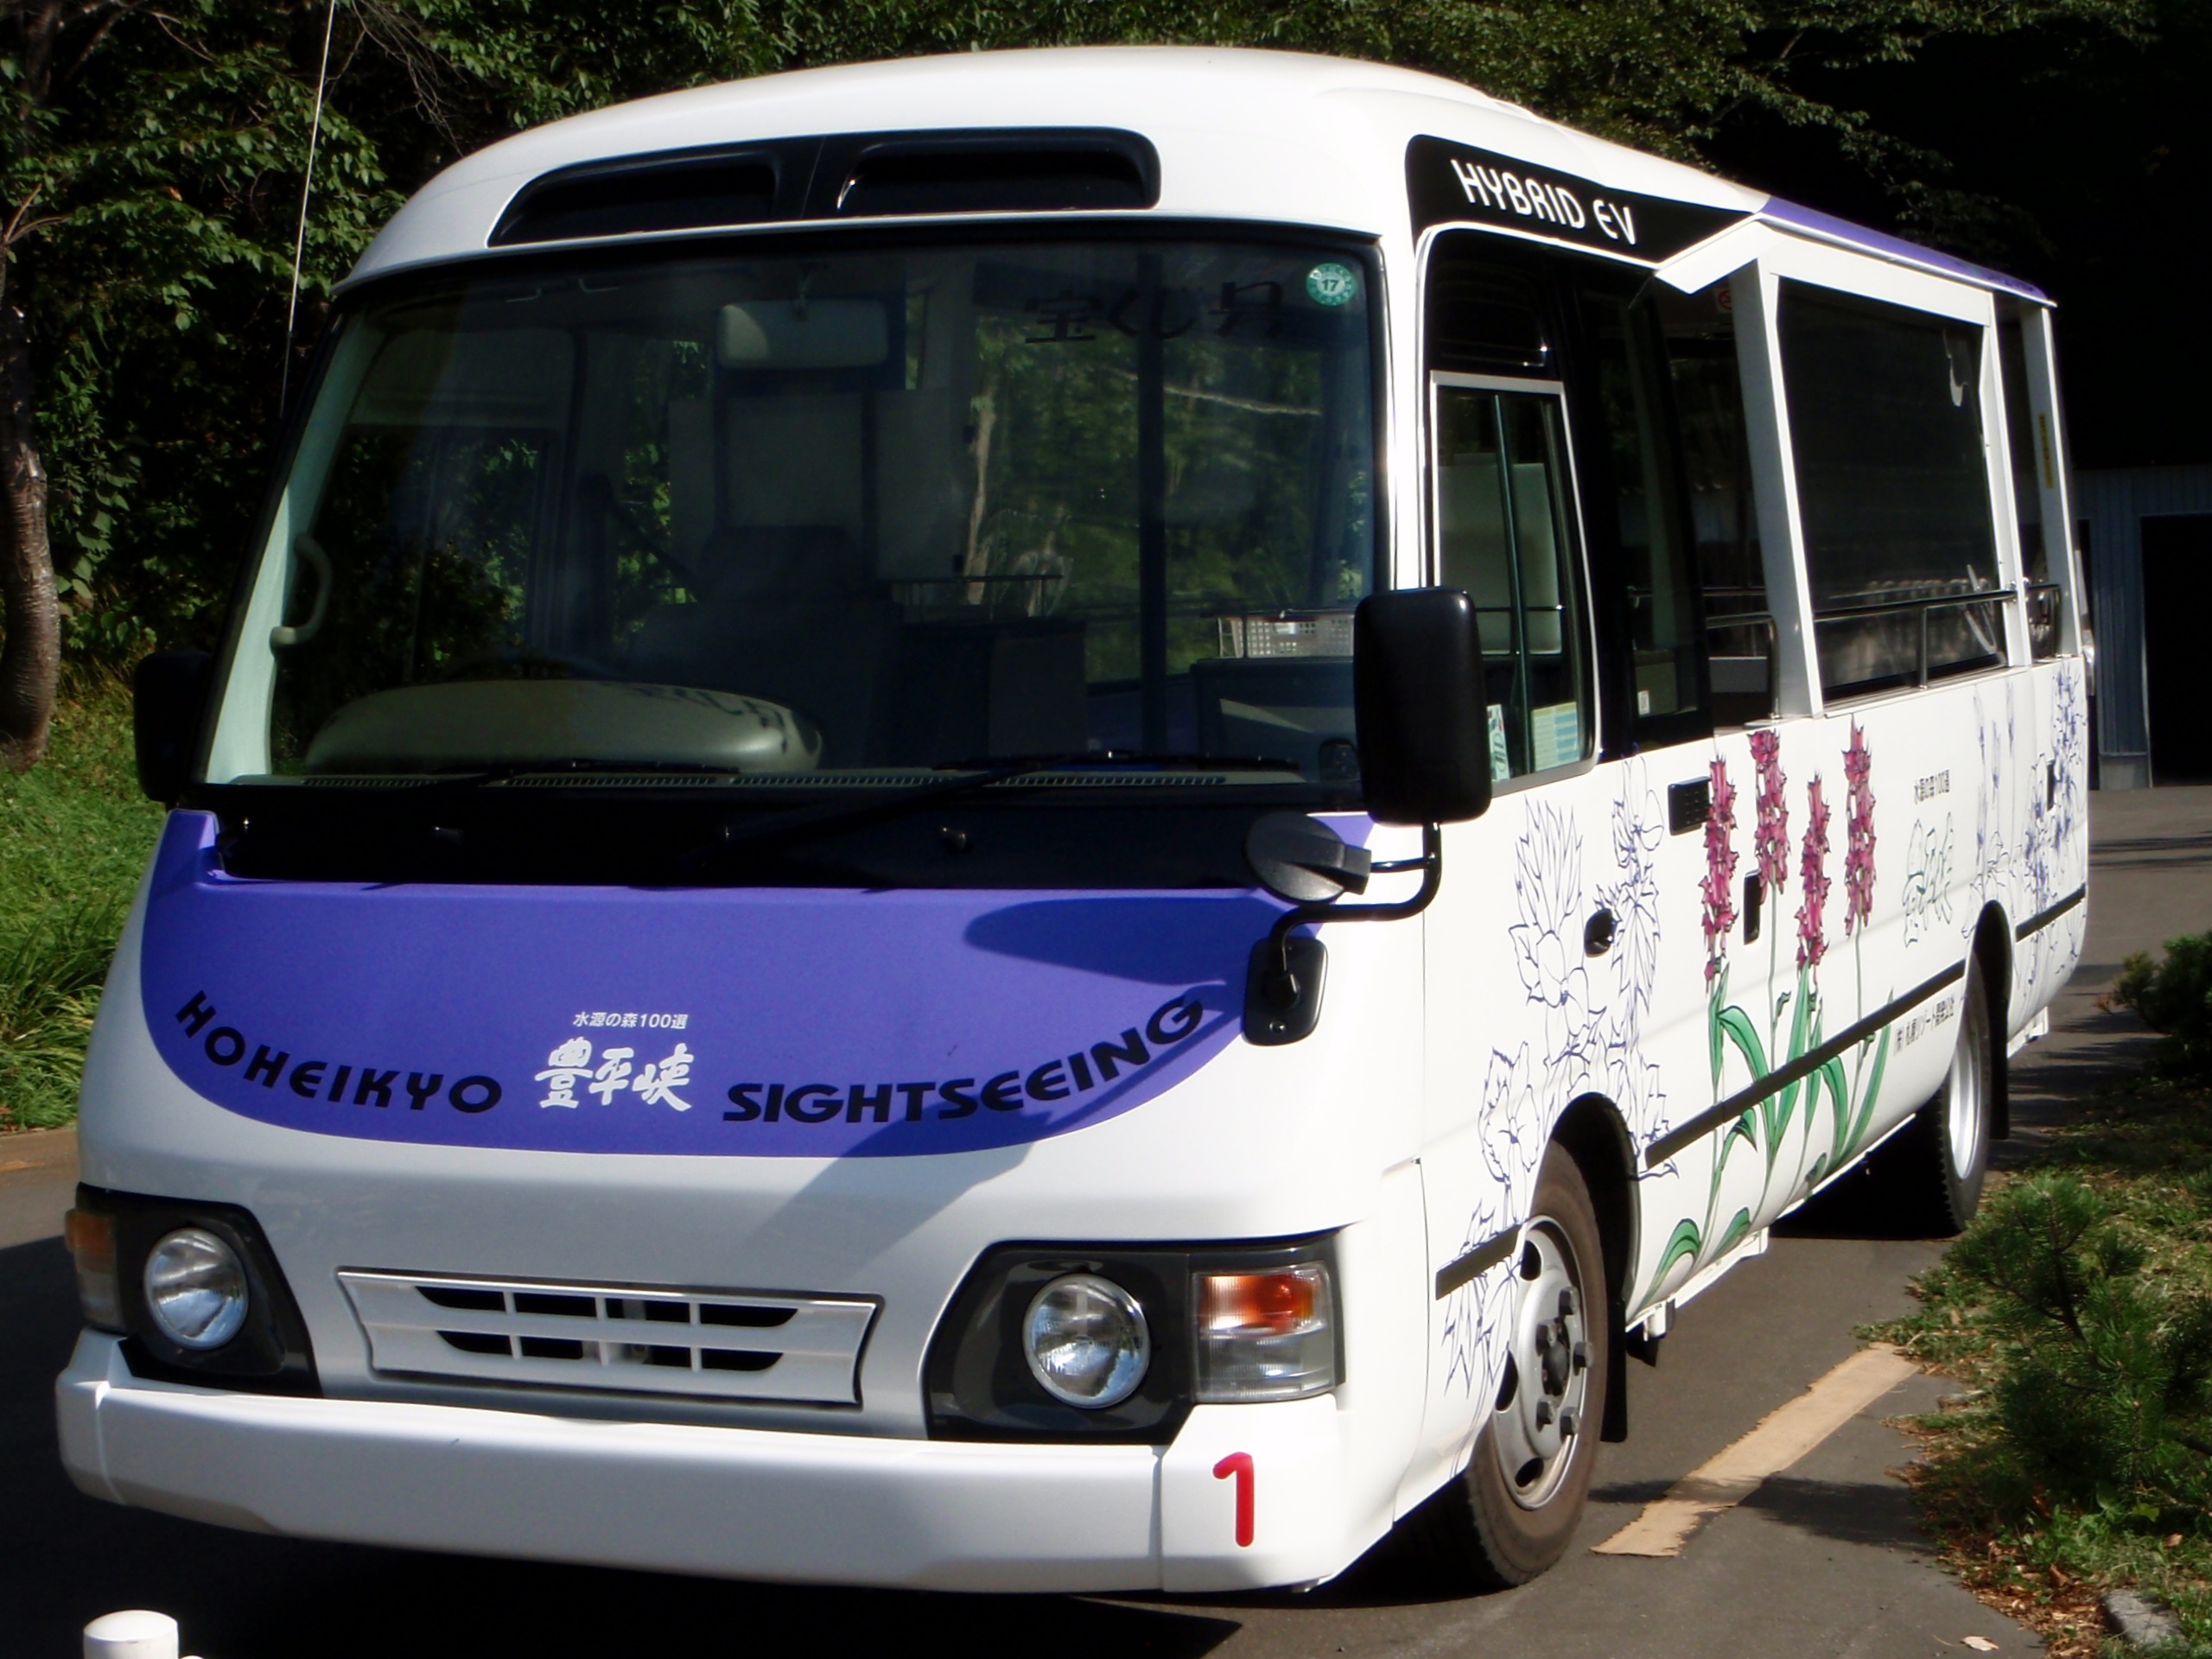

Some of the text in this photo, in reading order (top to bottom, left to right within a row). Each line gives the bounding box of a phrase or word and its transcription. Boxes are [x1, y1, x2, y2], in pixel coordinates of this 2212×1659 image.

[1451, 159, 1636, 245] HYBRID EV
[1322, 278, 1339, 292] 17
[175, 990, 502, 1114] HOHEIKYO
[573, 1011, 688, 1029] 水源の森100選
[722, 995, 1204, 1123] SIGHTSEEING
[1212, 1452, 1254, 1547] 1
